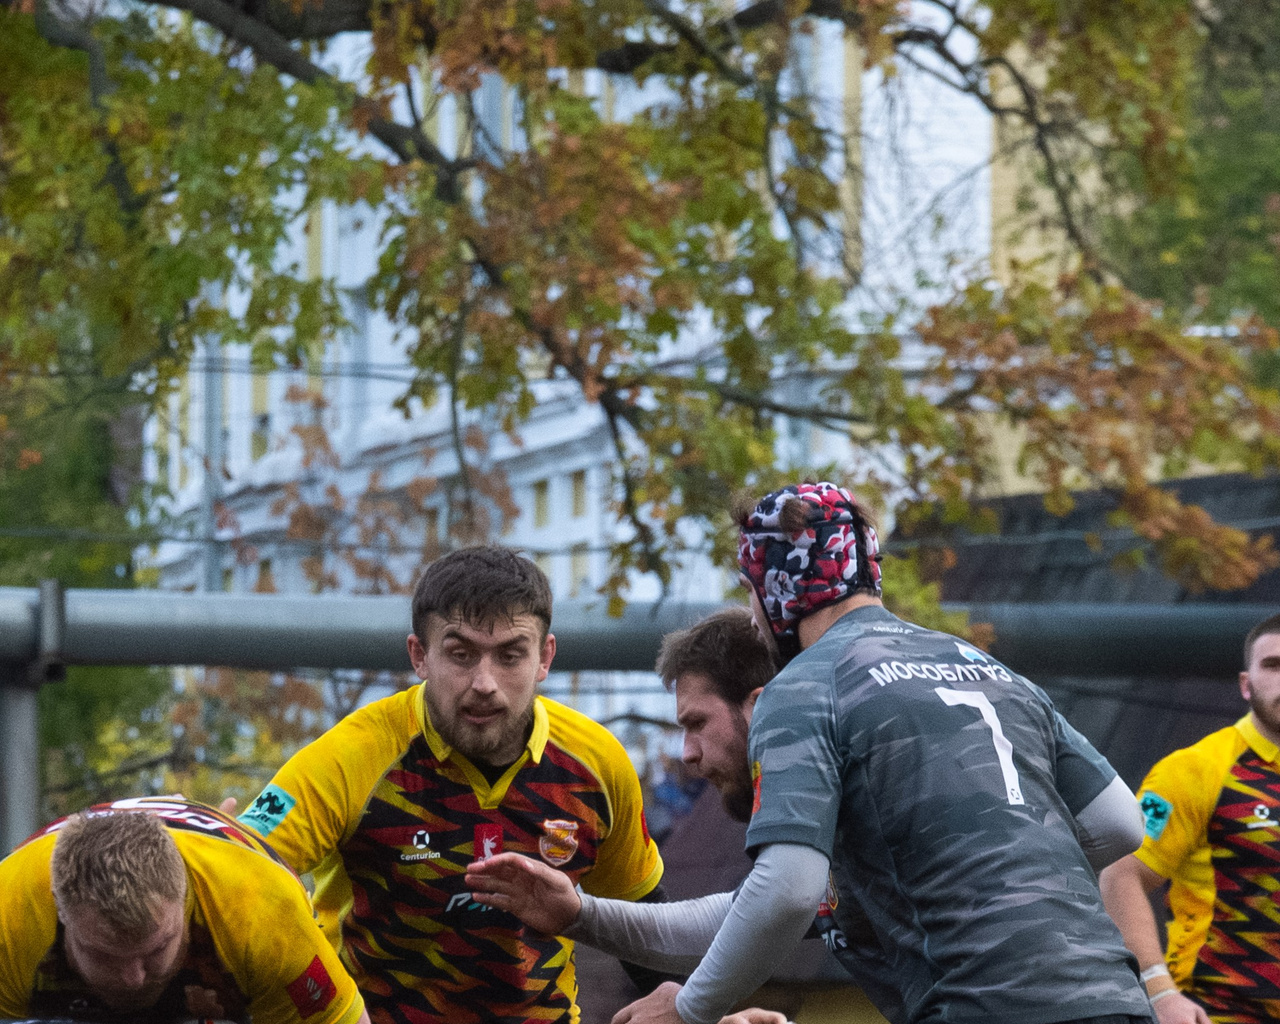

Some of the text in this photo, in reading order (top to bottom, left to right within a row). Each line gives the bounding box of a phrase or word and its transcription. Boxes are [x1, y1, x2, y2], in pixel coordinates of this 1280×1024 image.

[868, 660, 1013, 687] МОСОБЛГАЗ
[934, 686, 1025, 806] 7
[400, 851, 441, 861] centurion
